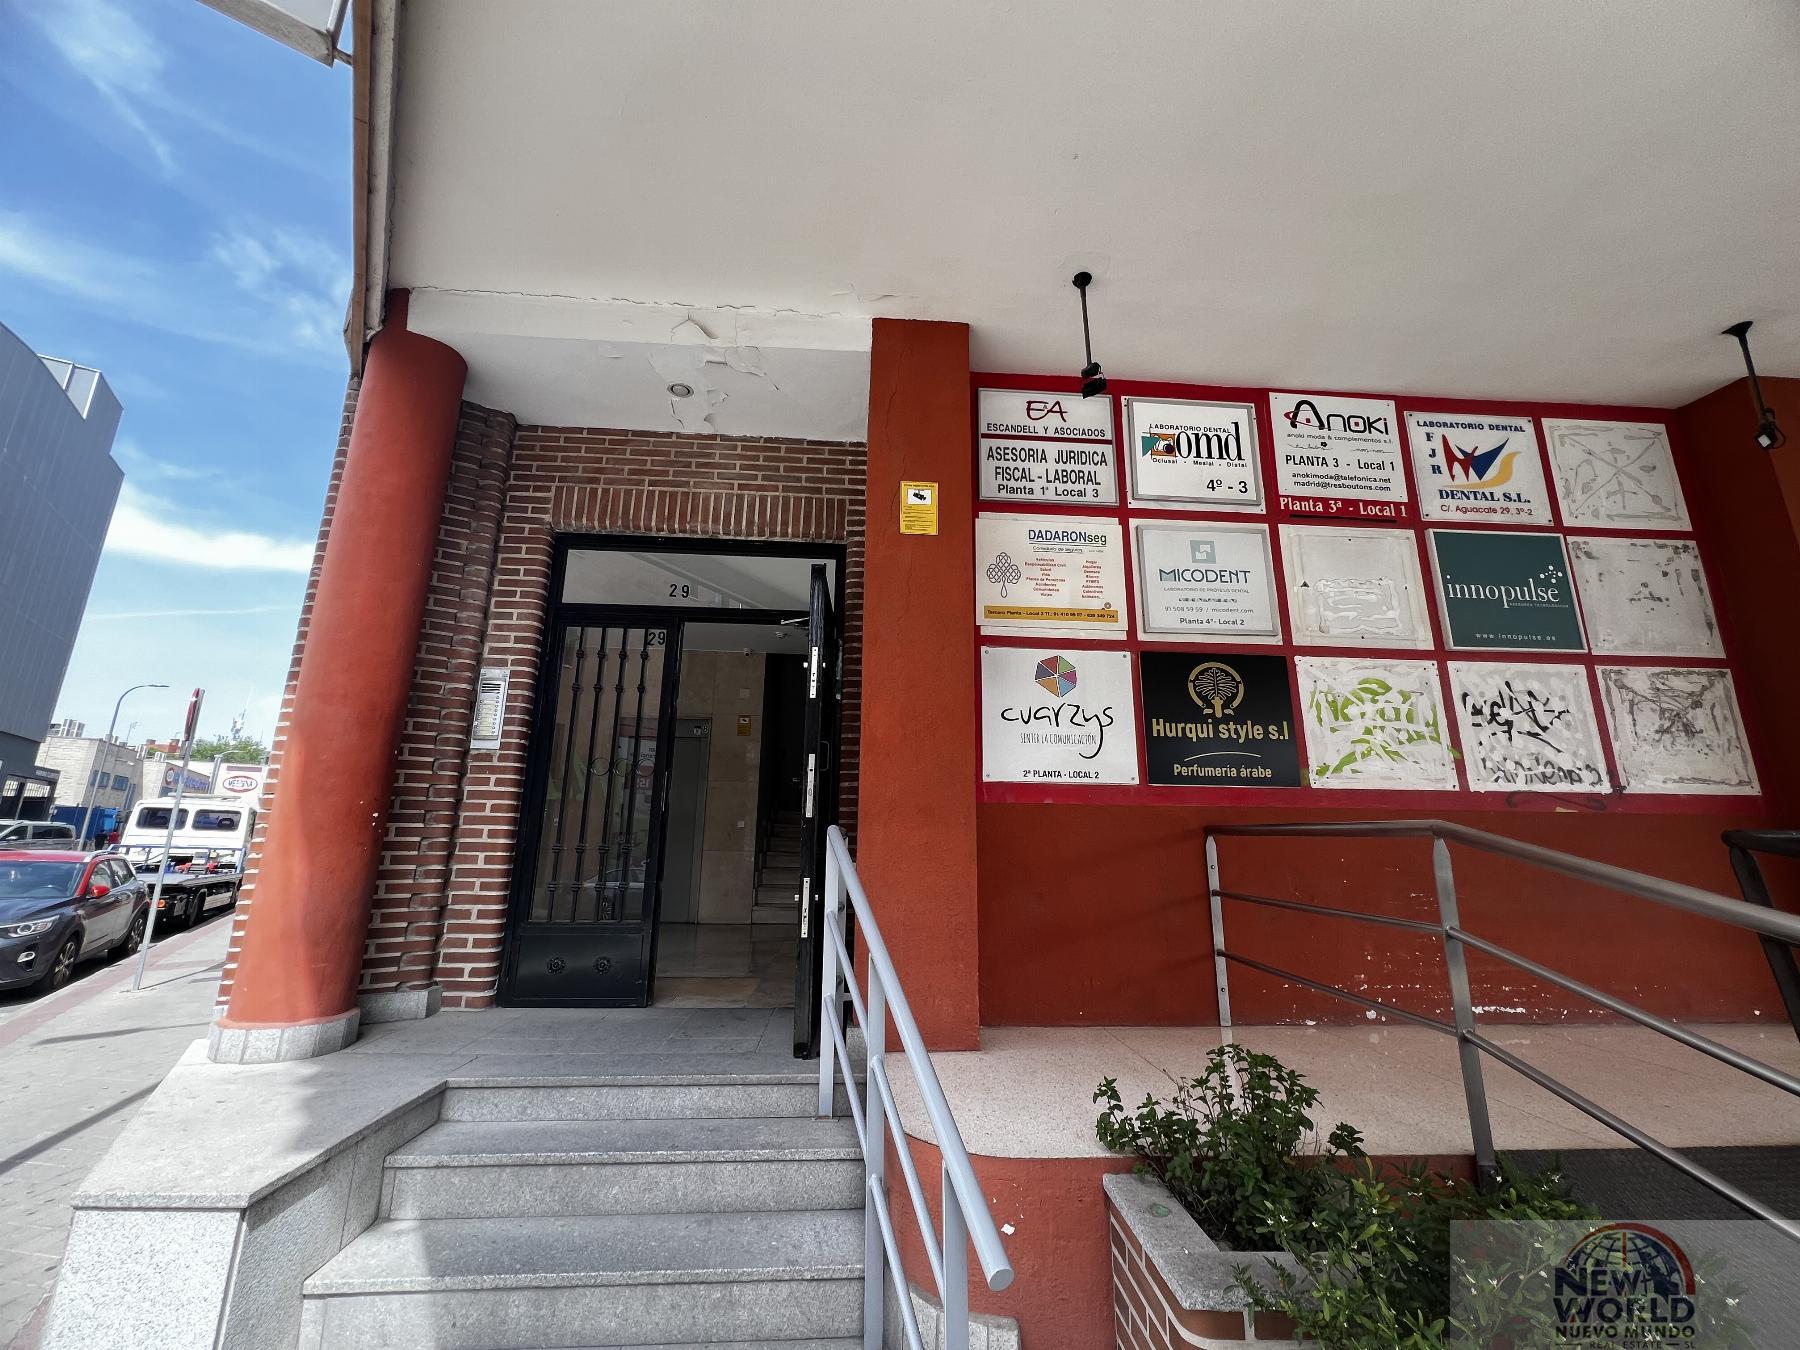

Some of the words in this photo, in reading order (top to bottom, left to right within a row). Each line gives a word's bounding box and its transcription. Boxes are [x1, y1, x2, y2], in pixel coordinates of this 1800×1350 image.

[986, 422, 1038, 434] ESCANDELL
[1043, 426, 1049, 434] Y
[1053, 426, 1106, 437] ASOCIADOS
[1149, 423, 1201, 432] LABORATORIO
[1203, 426, 1231, 434] DENTAL
[1416, 420, 1484, 430] LABORATORIO
[1488, 424, 1526, 432] DENTAL
[1175, 421, 1245, 461] omd
[987, 446, 1048, 463] ASESORIA
[1054, 449, 1108, 466] JURIDICA
[1285, 454, 1329, 468] PLANTA
[1333, 457, 1339, 468] 3
[1358, 459, 1385, 471] Local
[1390, 461, 1395, 471] 1
[995, 466, 1035, 482] FISCAL
[1046, 468, 1102, 485] LABORAL
[1292, 472, 1392, 484] anokimoda@telefonica.net
[997, 484, 1034, 495] Planta
[1054, 486, 1087, 497] Local
[1092, 489, 1099, 497] 3
[1238, 481, 1248, 493] 3
[1293, 480, 1391, 492] madrid@tresboutons.com
[1438, 489, 1500, 501] DENTAL
[1502, 492, 1531, 503] S.L.
[1280, 497, 1324, 512] Planta
[1328, 500, 1342, 513] 3ª
[1359, 502, 1396, 517] Local
[1400, 505, 1408, 517] 1
[1455, 505, 1498, 514] Aguacate
[1028, 529, 1107, 545] DADARONseg
[1159, 568, 1251, 584] MICODENT
[669, 583, 689, 598] 29
[1446, 574, 1560, 608] innopulse
[1179, 617, 1204, 625] Planta
[647, 631, 666, 646] 29
[1151, 718, 1214, 742] Hurqui
[1218, 720, 1264, 744] style
[1268, 720, 1289, 740] s.l
[1033, 769, 1062, 779] PLANTA
[1068, 770, 1093, 779] LOCAL
[1094, 771, 1100, 779] 2
[1173, 763, 1237, 777] Perfumería
[1240, 764, 1272, 778] árabe
